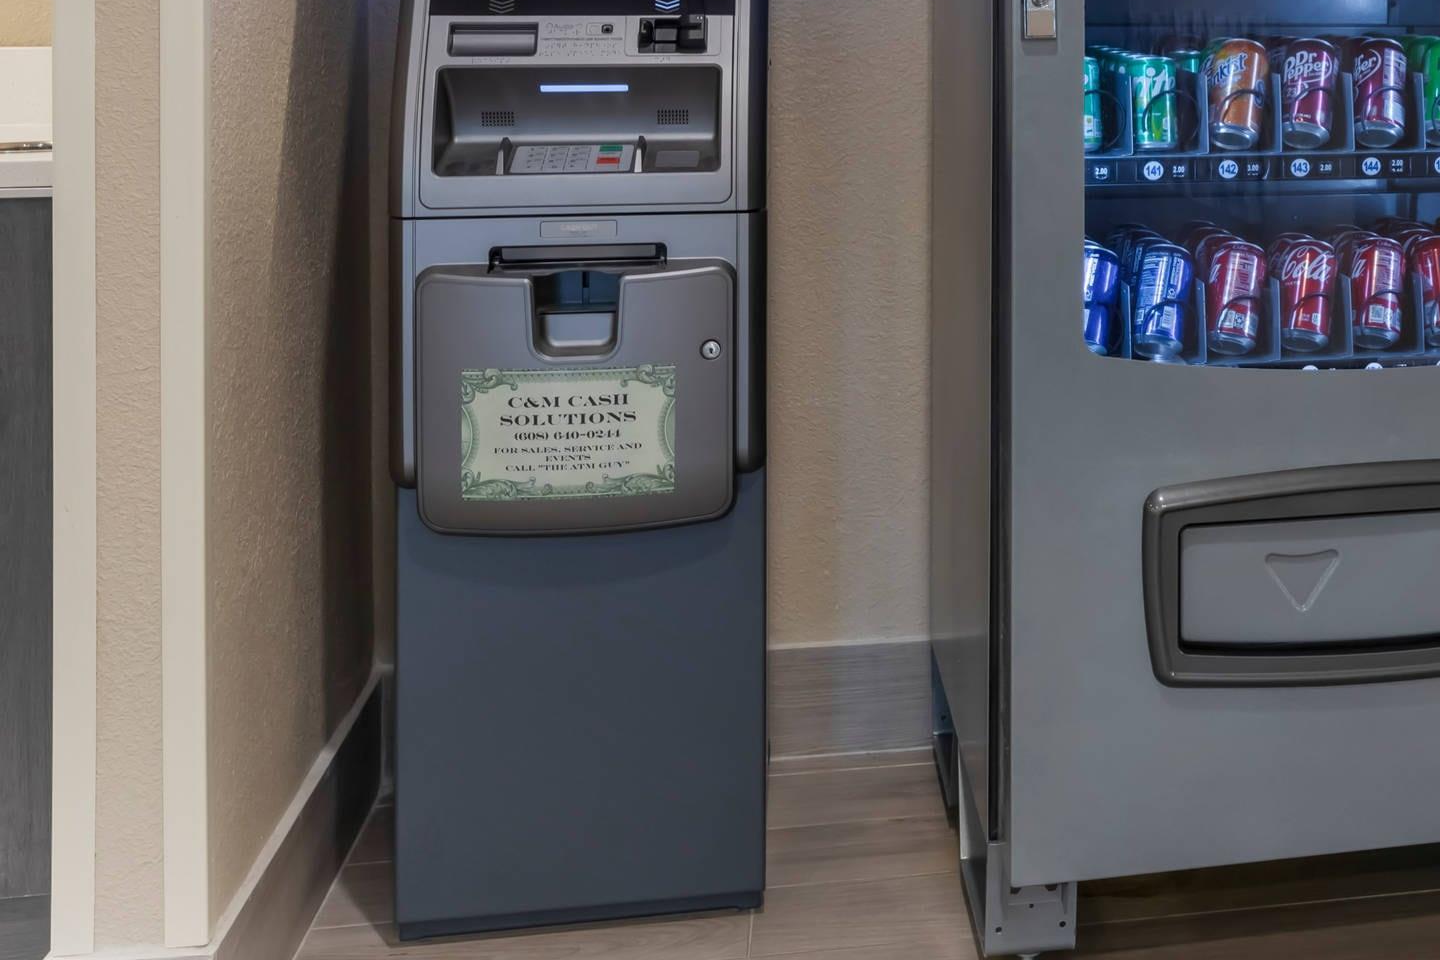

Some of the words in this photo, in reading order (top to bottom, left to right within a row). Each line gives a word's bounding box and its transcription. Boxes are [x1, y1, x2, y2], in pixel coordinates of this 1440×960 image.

[1295, 51, 1317, 65] Dr
[1284, 56, 1329, 83] Pepper
[1095, 167, 1108, 175] 2.00
[1145, 165, 1162, 177] 141
[1173, 165, 1185, 173] 2.00
[1220, 164, 1237, 175] 142
[1292, 162, 1309, 173] 143
[1363, 160, 1379, 171] 144
[1391, 159, 1404, 167] 2.00
[1281, 245, 1334, 283] Cola
[507, 396, 561, 408] C&M
[568, 393, 629, 407] CASH
[500, 411, 637, 427] SOLUTIONS
[514, 430, 549, 441] (608)
[553, 429, 621, 440] 640-0244
[493, 446, 519, 454] FOR
[563, 444, 615, 453] SERVICE
[617, 442, 643, 451] AND
[545, 454, 592, 462] EVENTS
[505, 464, 536, 472] CALL
[538, 463, 569, 472] "THE
[569, 462, 596, 471] ATM
[598, 460, 631, 469] GUY"
